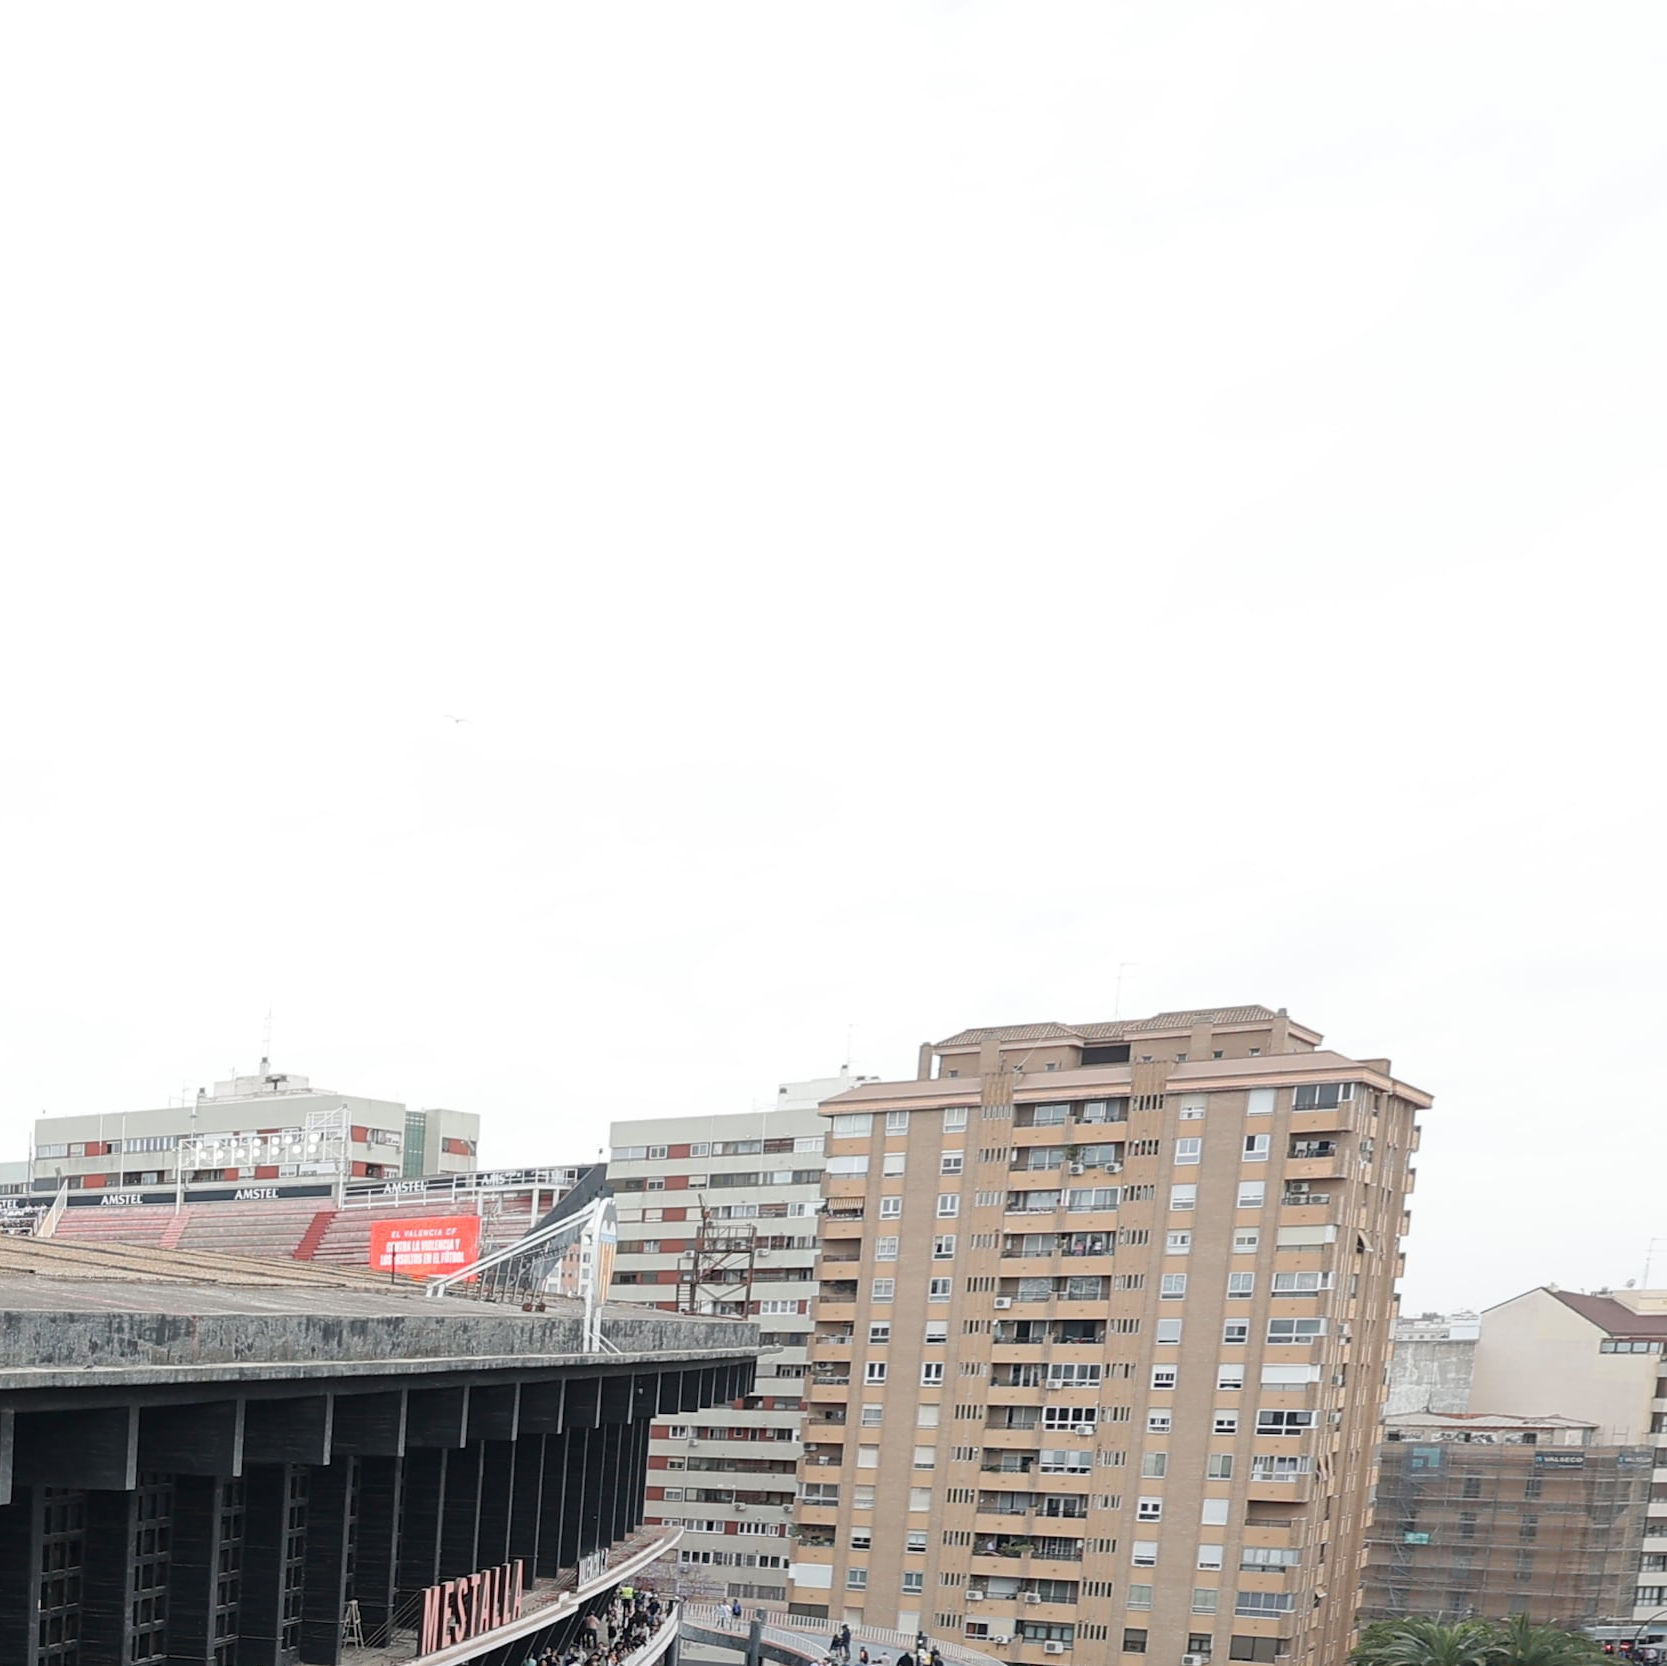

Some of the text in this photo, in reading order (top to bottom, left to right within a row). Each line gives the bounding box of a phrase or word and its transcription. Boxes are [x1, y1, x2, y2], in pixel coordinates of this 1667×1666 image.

[234, 1188, 279, 1201] AMSTEL
[383, 1180, 428, 1195] AMSTEL
[101, 1193, 143, 1206] AMSTEL
[421, 1559, 523, 1656] MESTALLA
